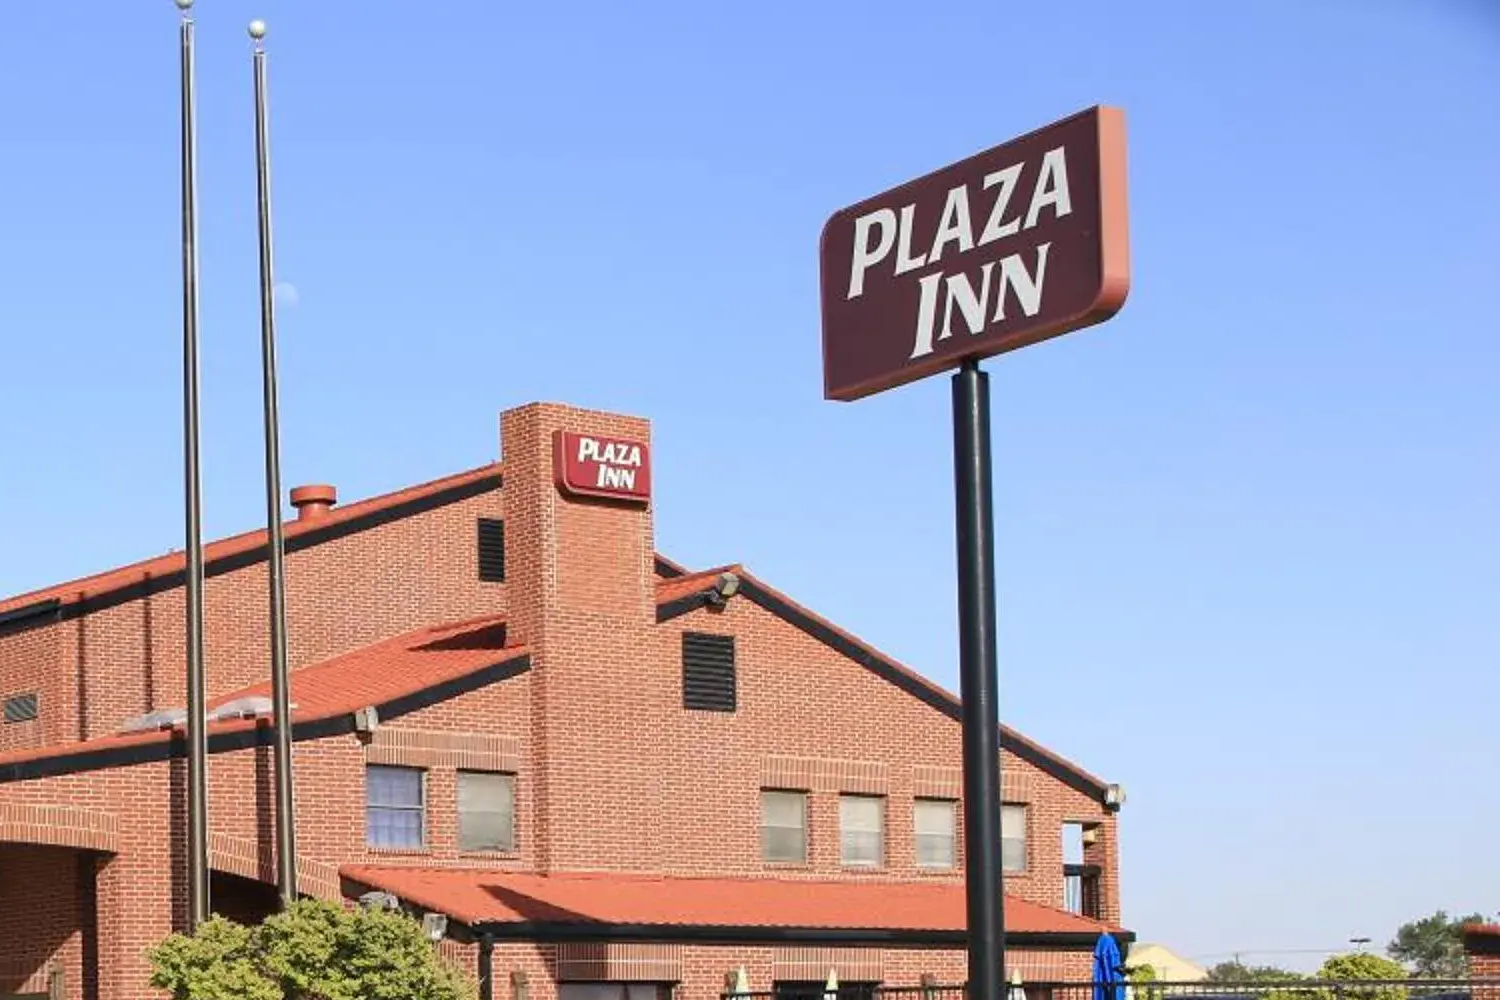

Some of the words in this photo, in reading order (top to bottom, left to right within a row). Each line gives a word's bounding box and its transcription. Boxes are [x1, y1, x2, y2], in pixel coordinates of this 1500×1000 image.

[847, 145, 1073, 300] PLAZA
[909, 241, 1051, 360] INN
[578, 437, 642, 467] PLAZA
[596, 463, 635, 490] INN
